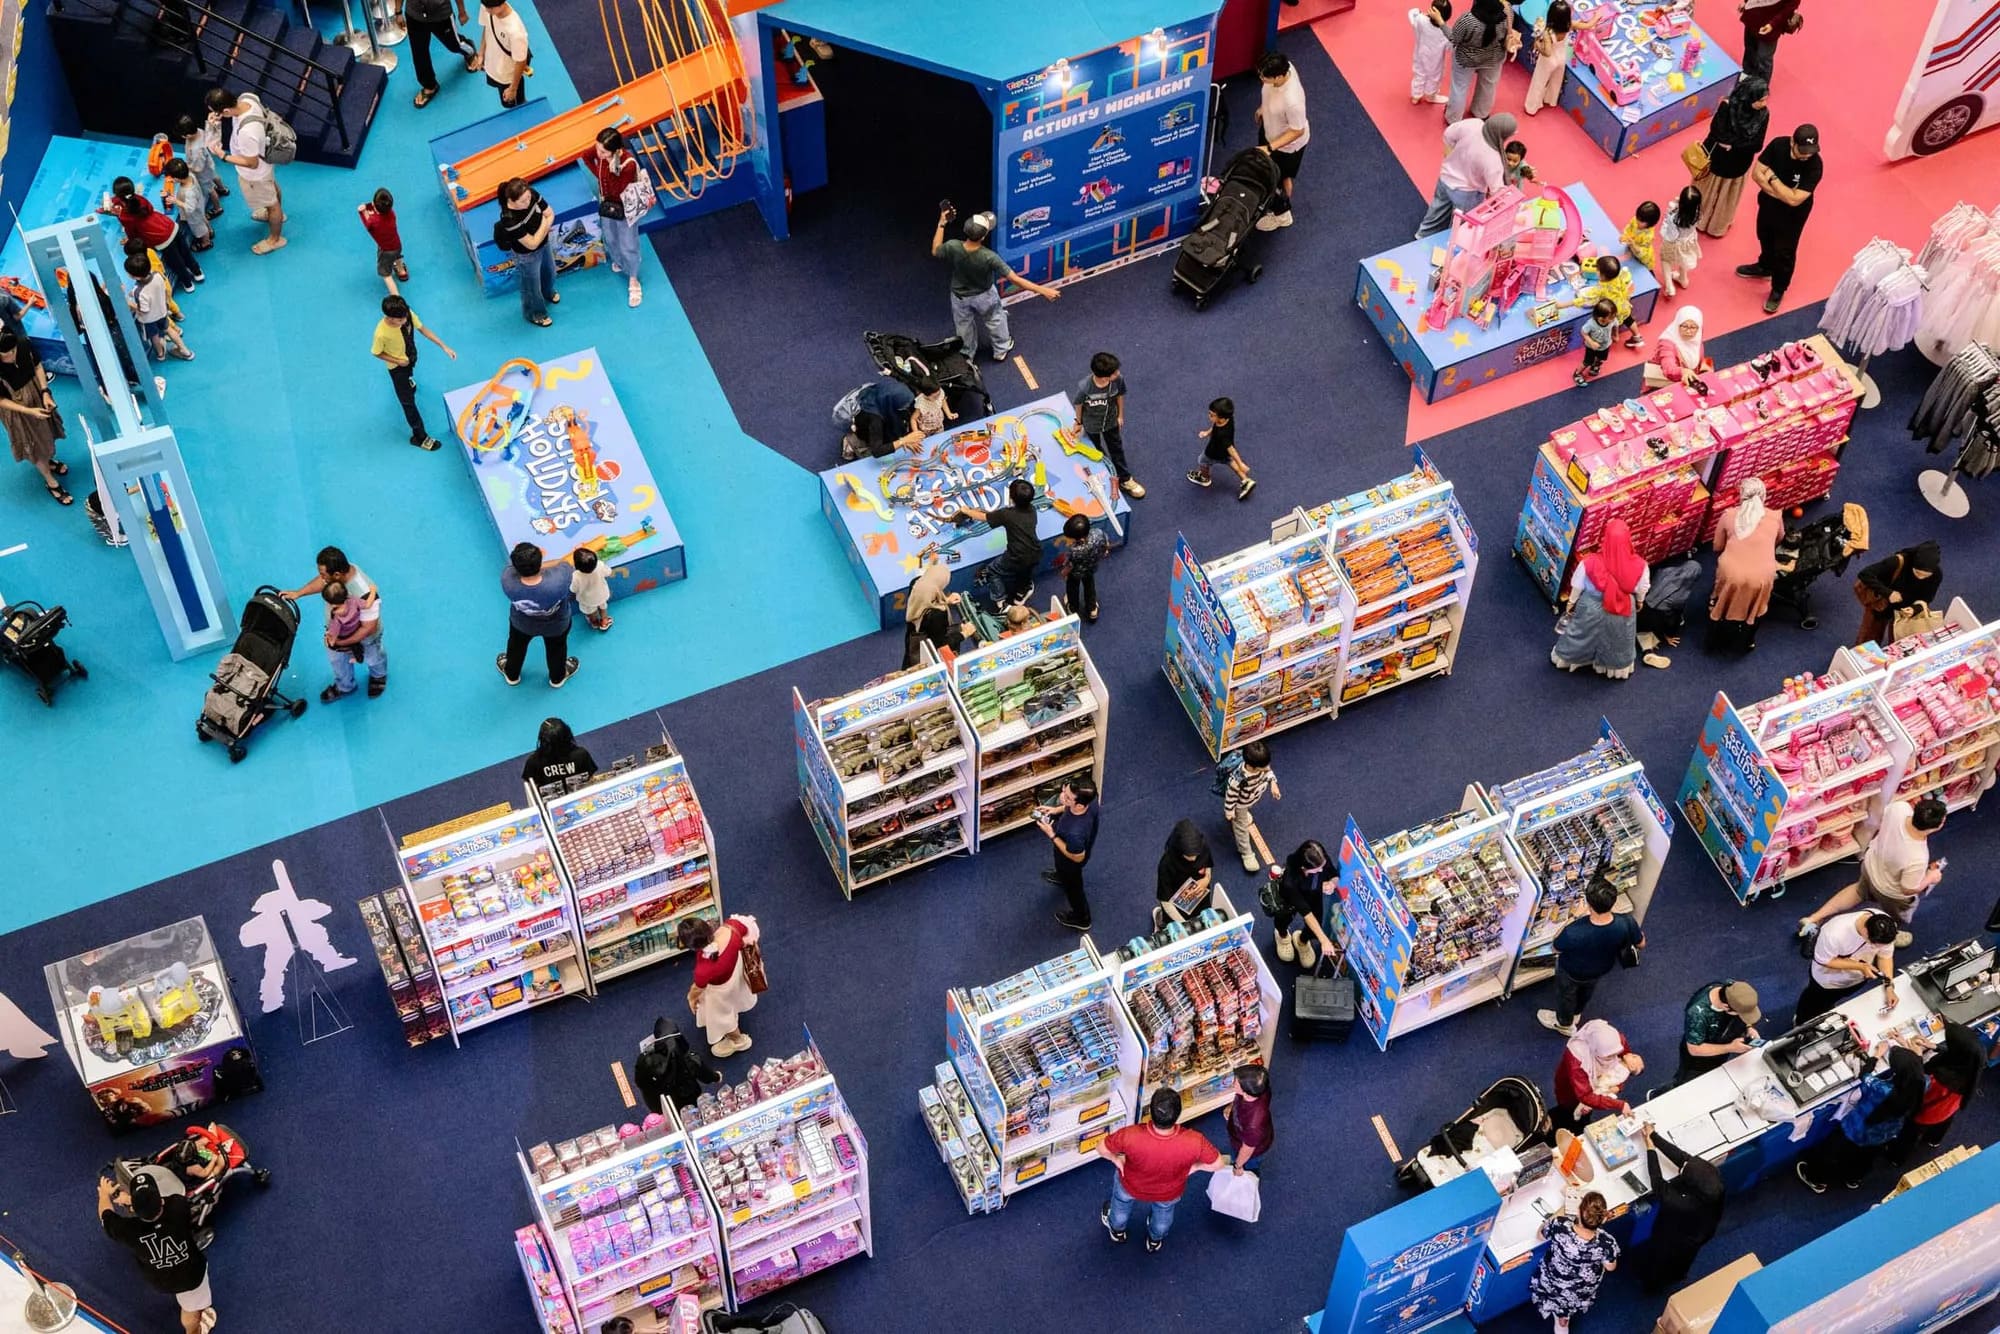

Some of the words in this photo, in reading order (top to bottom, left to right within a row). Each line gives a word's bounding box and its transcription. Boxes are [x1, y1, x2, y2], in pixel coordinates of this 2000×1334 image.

[1022, 107, 1100, 142] ACTIVITY
[1105, 75, 1194, 115] HIGHLIGHT
[1516, 338, 1569, 364] HOLIDAYS
[1523, 331, 1564, 353] SCHOOL
[513, 413, 581, 530] HOLIDAYS
[543, 761, 576, 777] CREW
[1722, 735, 1763, 800] HOLIDAYS
[139, 1231, 189, 1270] LA
